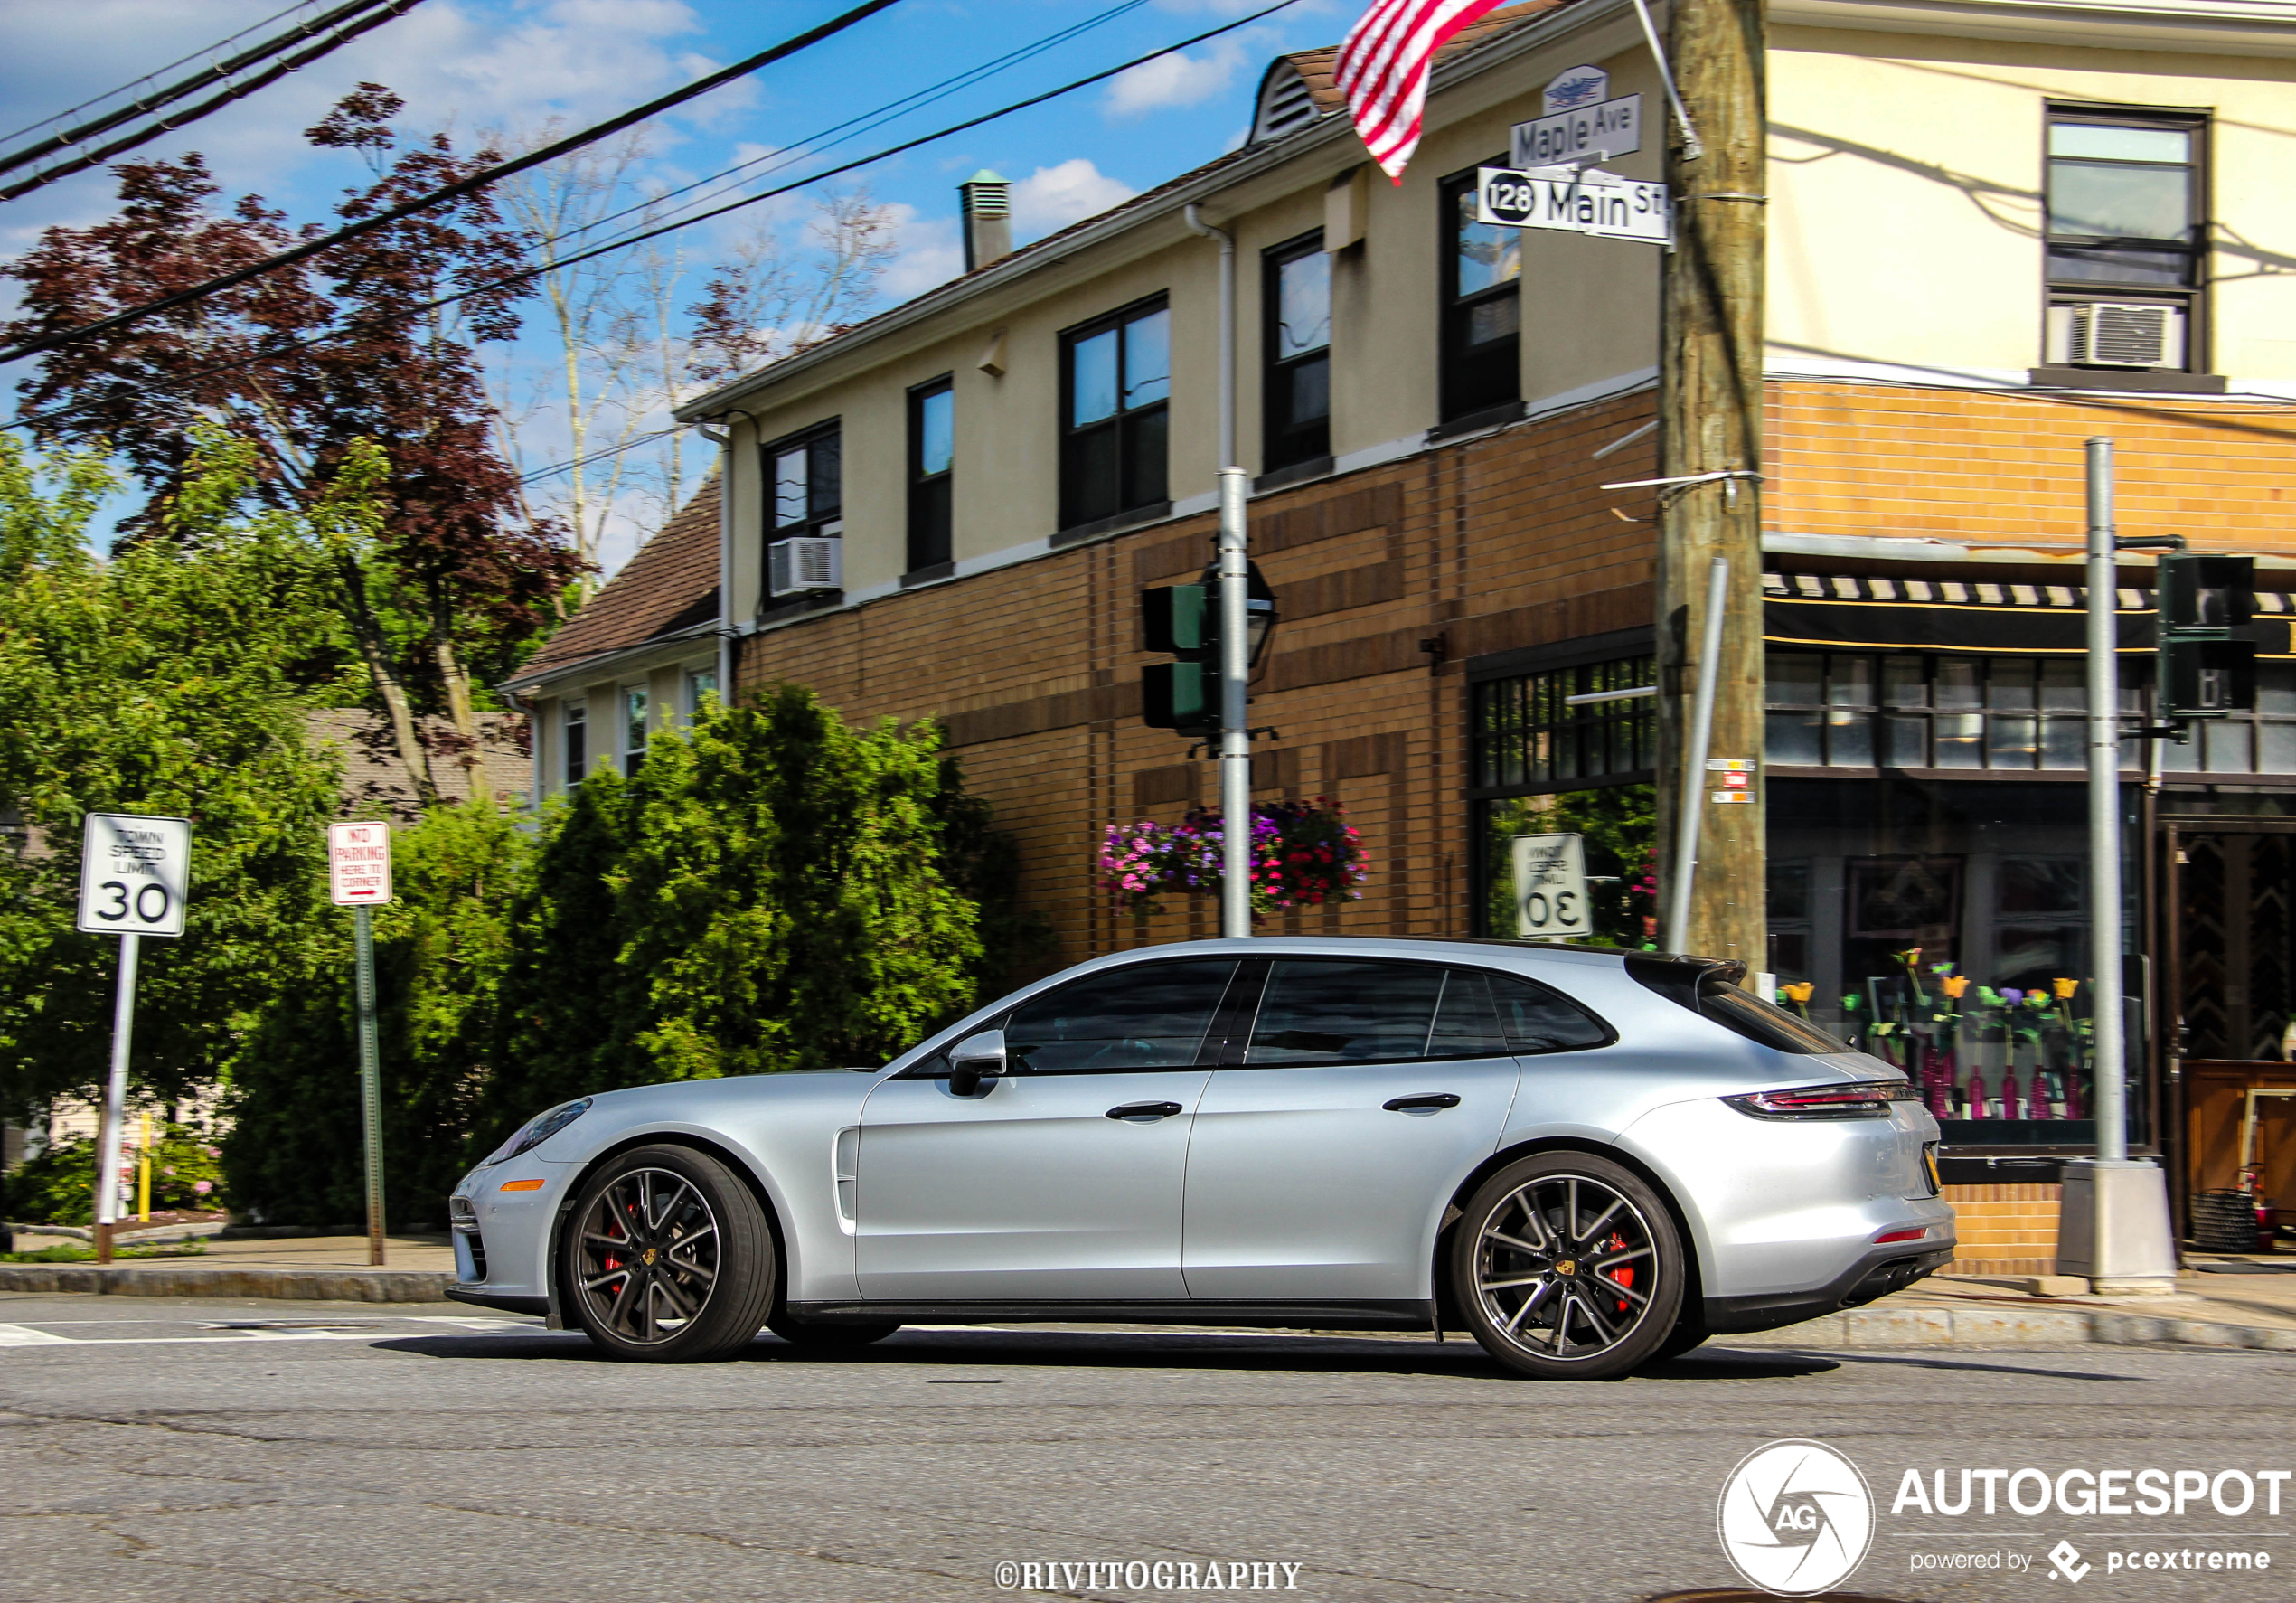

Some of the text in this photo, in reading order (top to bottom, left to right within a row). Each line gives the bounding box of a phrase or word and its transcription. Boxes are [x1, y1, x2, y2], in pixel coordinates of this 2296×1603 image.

[1518, 106, 1631, 163] Maple Ave
[1489, 182, 1662, 227] 128 Main St
[116, 829, 165, 844] TOWN
[347, 828, 371, 843] NO
[108, 845, 167, 860] SPEED
[334, 846, 385, 862] PARKING
[114, 861, 158, 875] LIMIT
[340, 864, 381, 875] HERE TO
[340, 877, 382, 887] CORNER
[95, 881, 169, 924] 30
